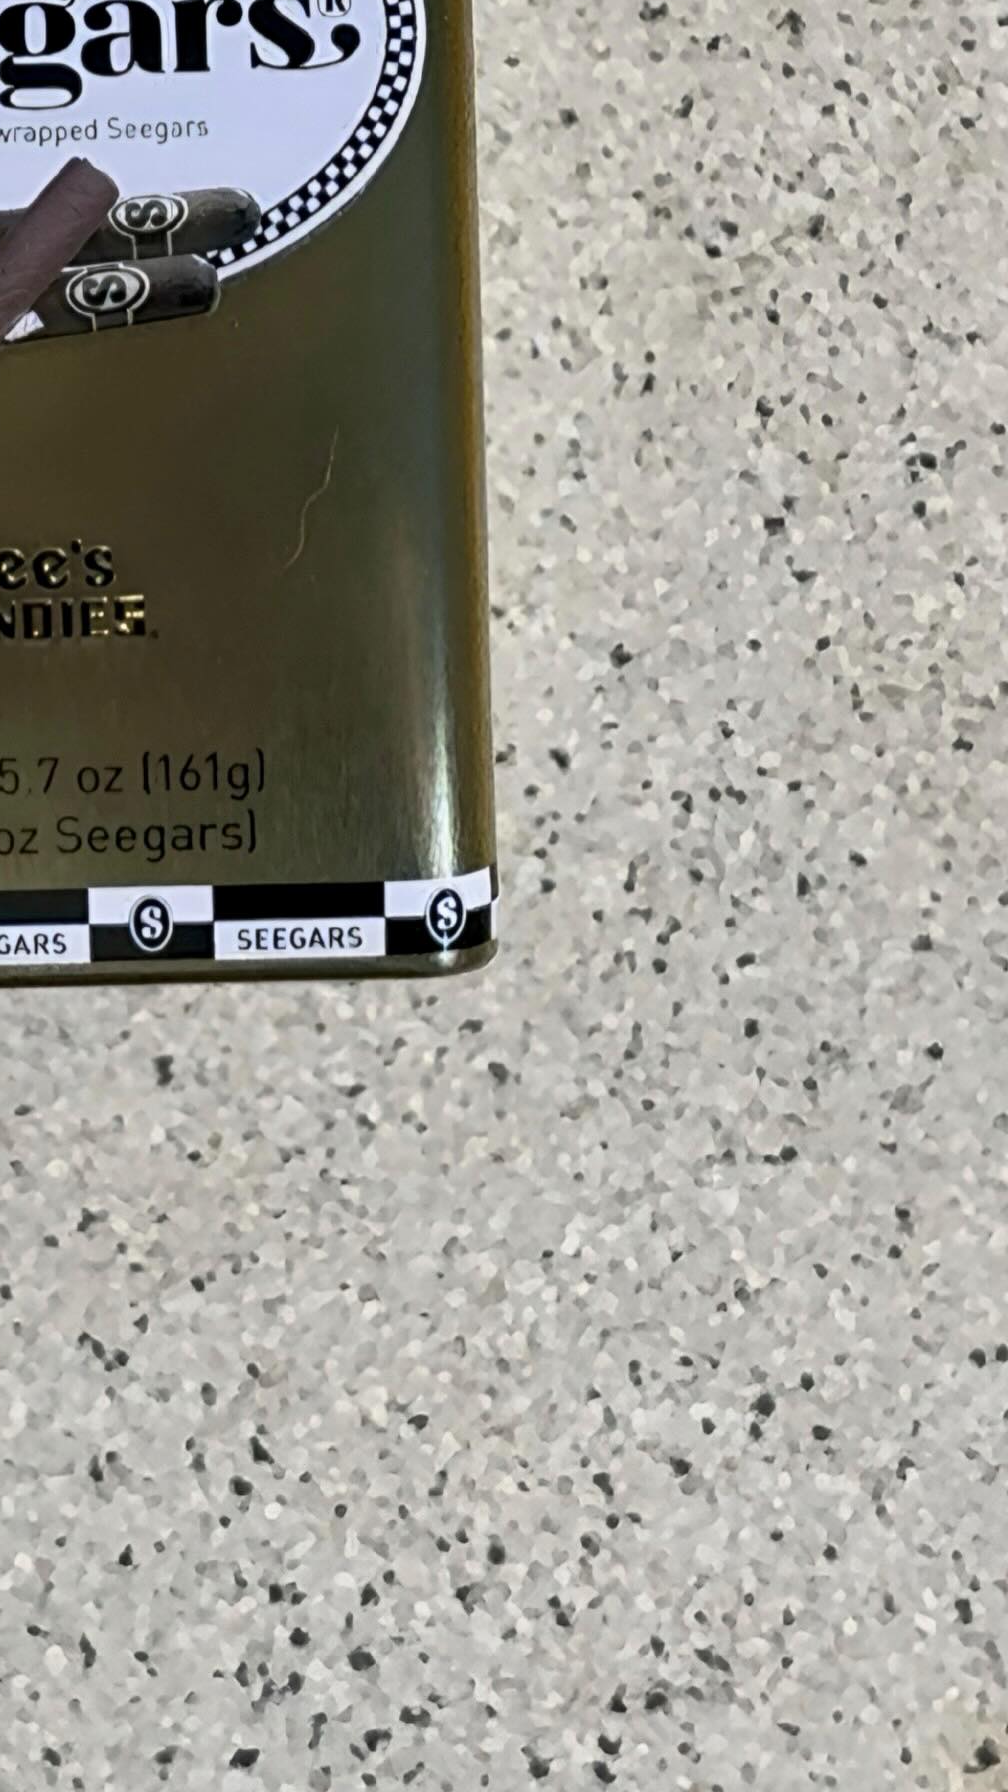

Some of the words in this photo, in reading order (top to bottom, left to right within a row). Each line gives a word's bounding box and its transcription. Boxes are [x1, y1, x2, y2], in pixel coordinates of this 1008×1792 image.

[108, 116, 209, 145] Seegars
[77, 764, 124, 794] oz
[141, 748, 265, 800] (161g)
[56, 809, 257, 862] Seegars)
[139, 907, 163, 940] S
[237, 925, 363, 951] SEEGARS
[436, 895, 457, 929] S
